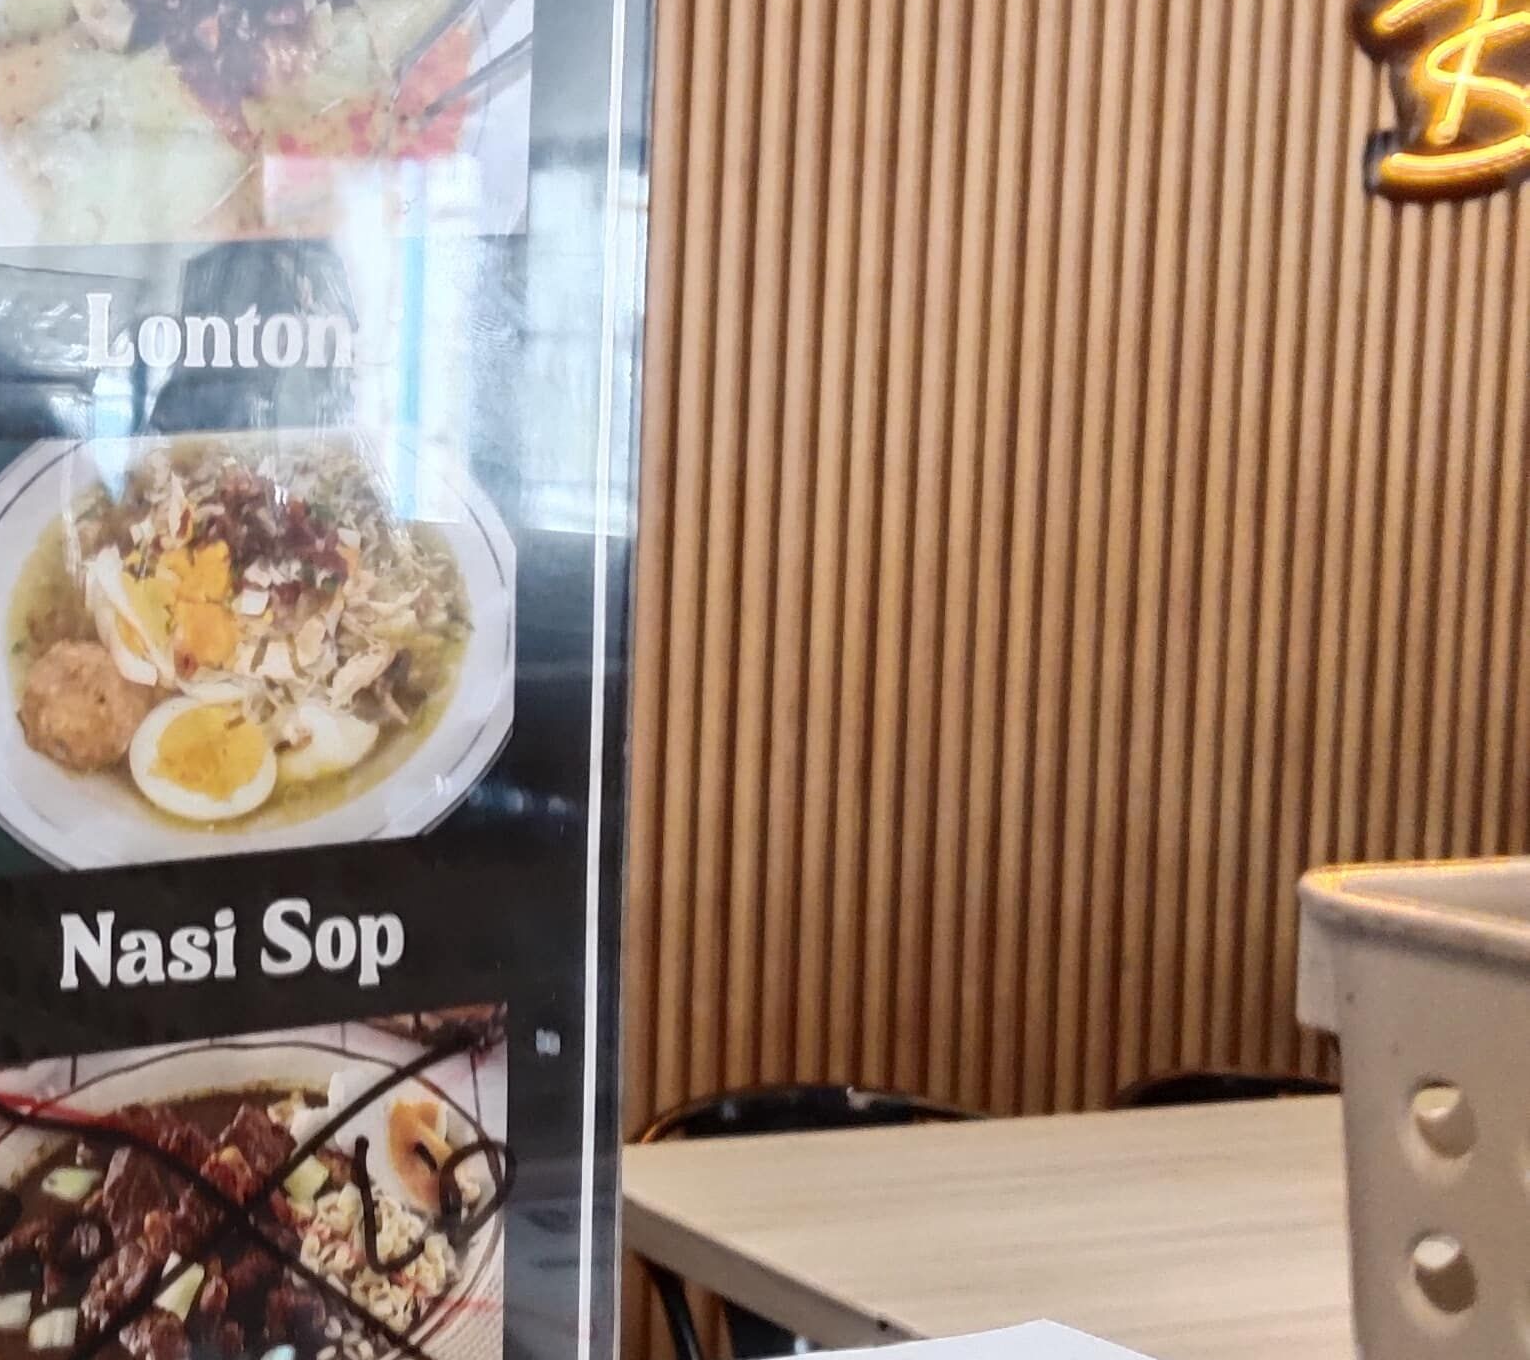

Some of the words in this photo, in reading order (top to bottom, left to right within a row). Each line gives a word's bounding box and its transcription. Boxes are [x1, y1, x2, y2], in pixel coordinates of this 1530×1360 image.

[82, 292, 400, 385] Lonton
[58, 906, 236, 992] Nasi
[258, 896, 407, 988] Sop
